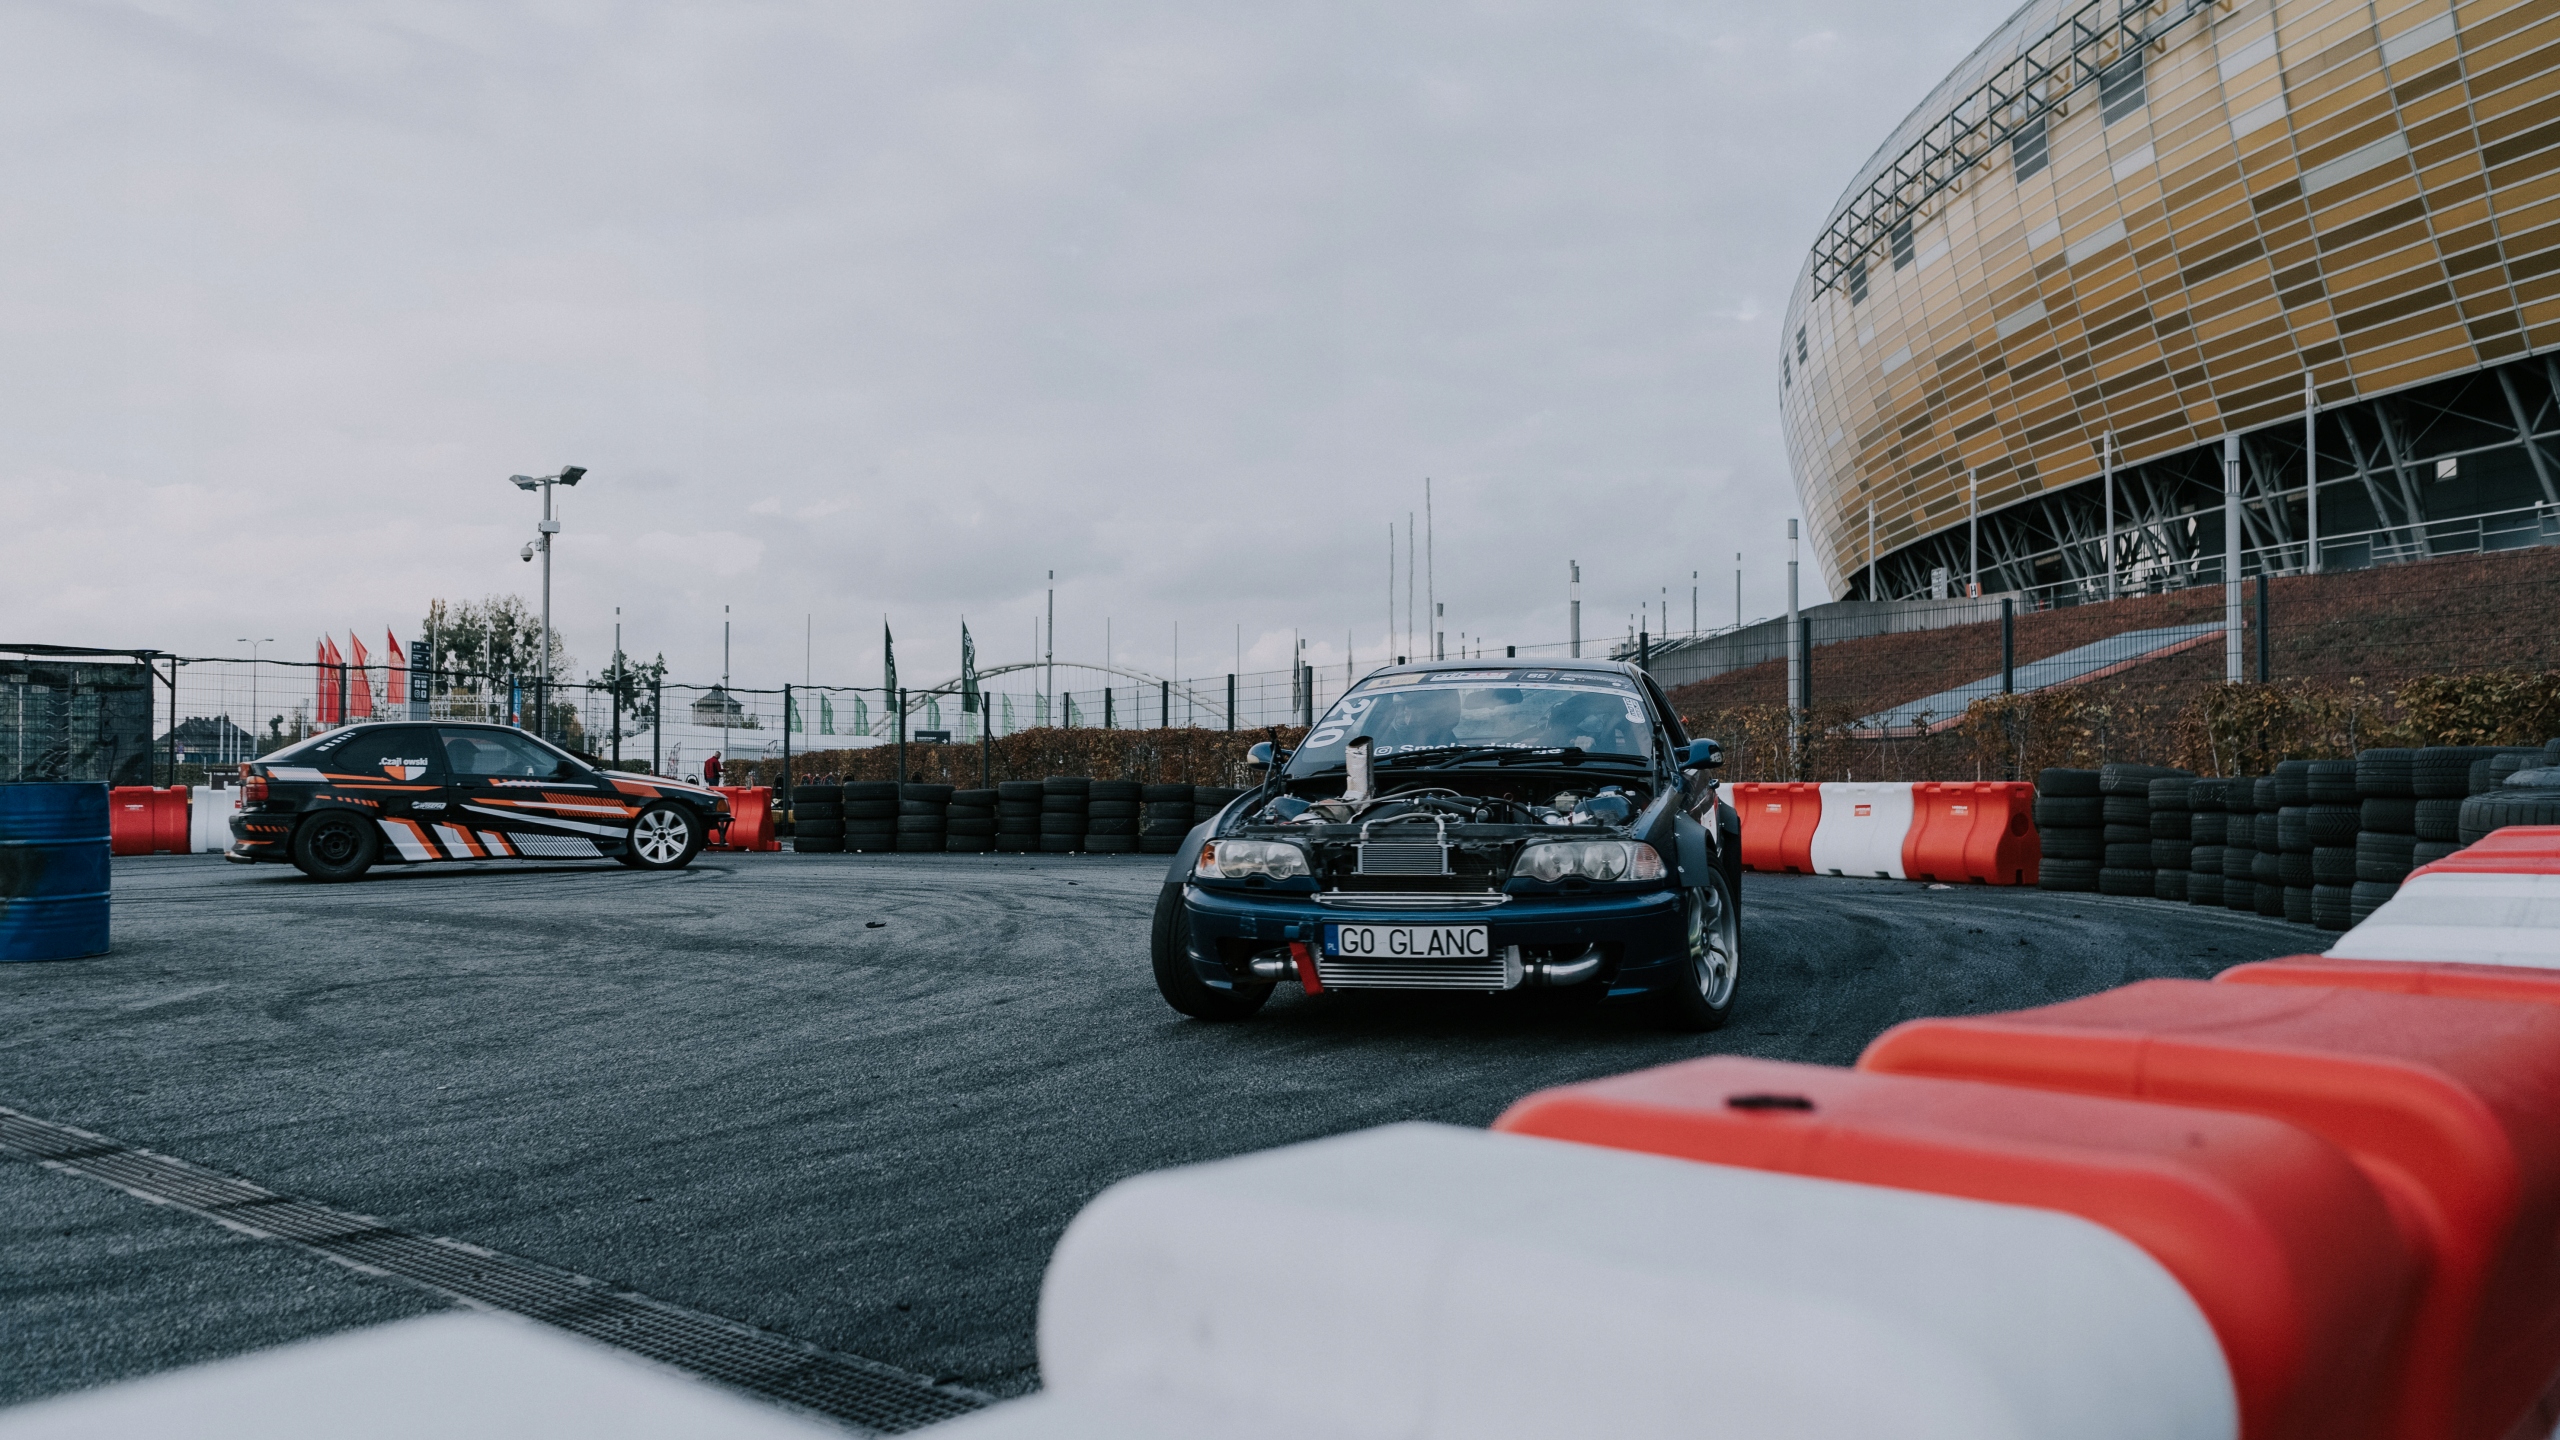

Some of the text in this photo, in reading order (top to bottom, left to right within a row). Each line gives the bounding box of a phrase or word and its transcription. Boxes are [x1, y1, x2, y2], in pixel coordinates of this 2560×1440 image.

[1304, 698, 1371, 749] 210
[1326, 942, 1337, 951] PL
[1389, 928, 1485, 956] GLANC
